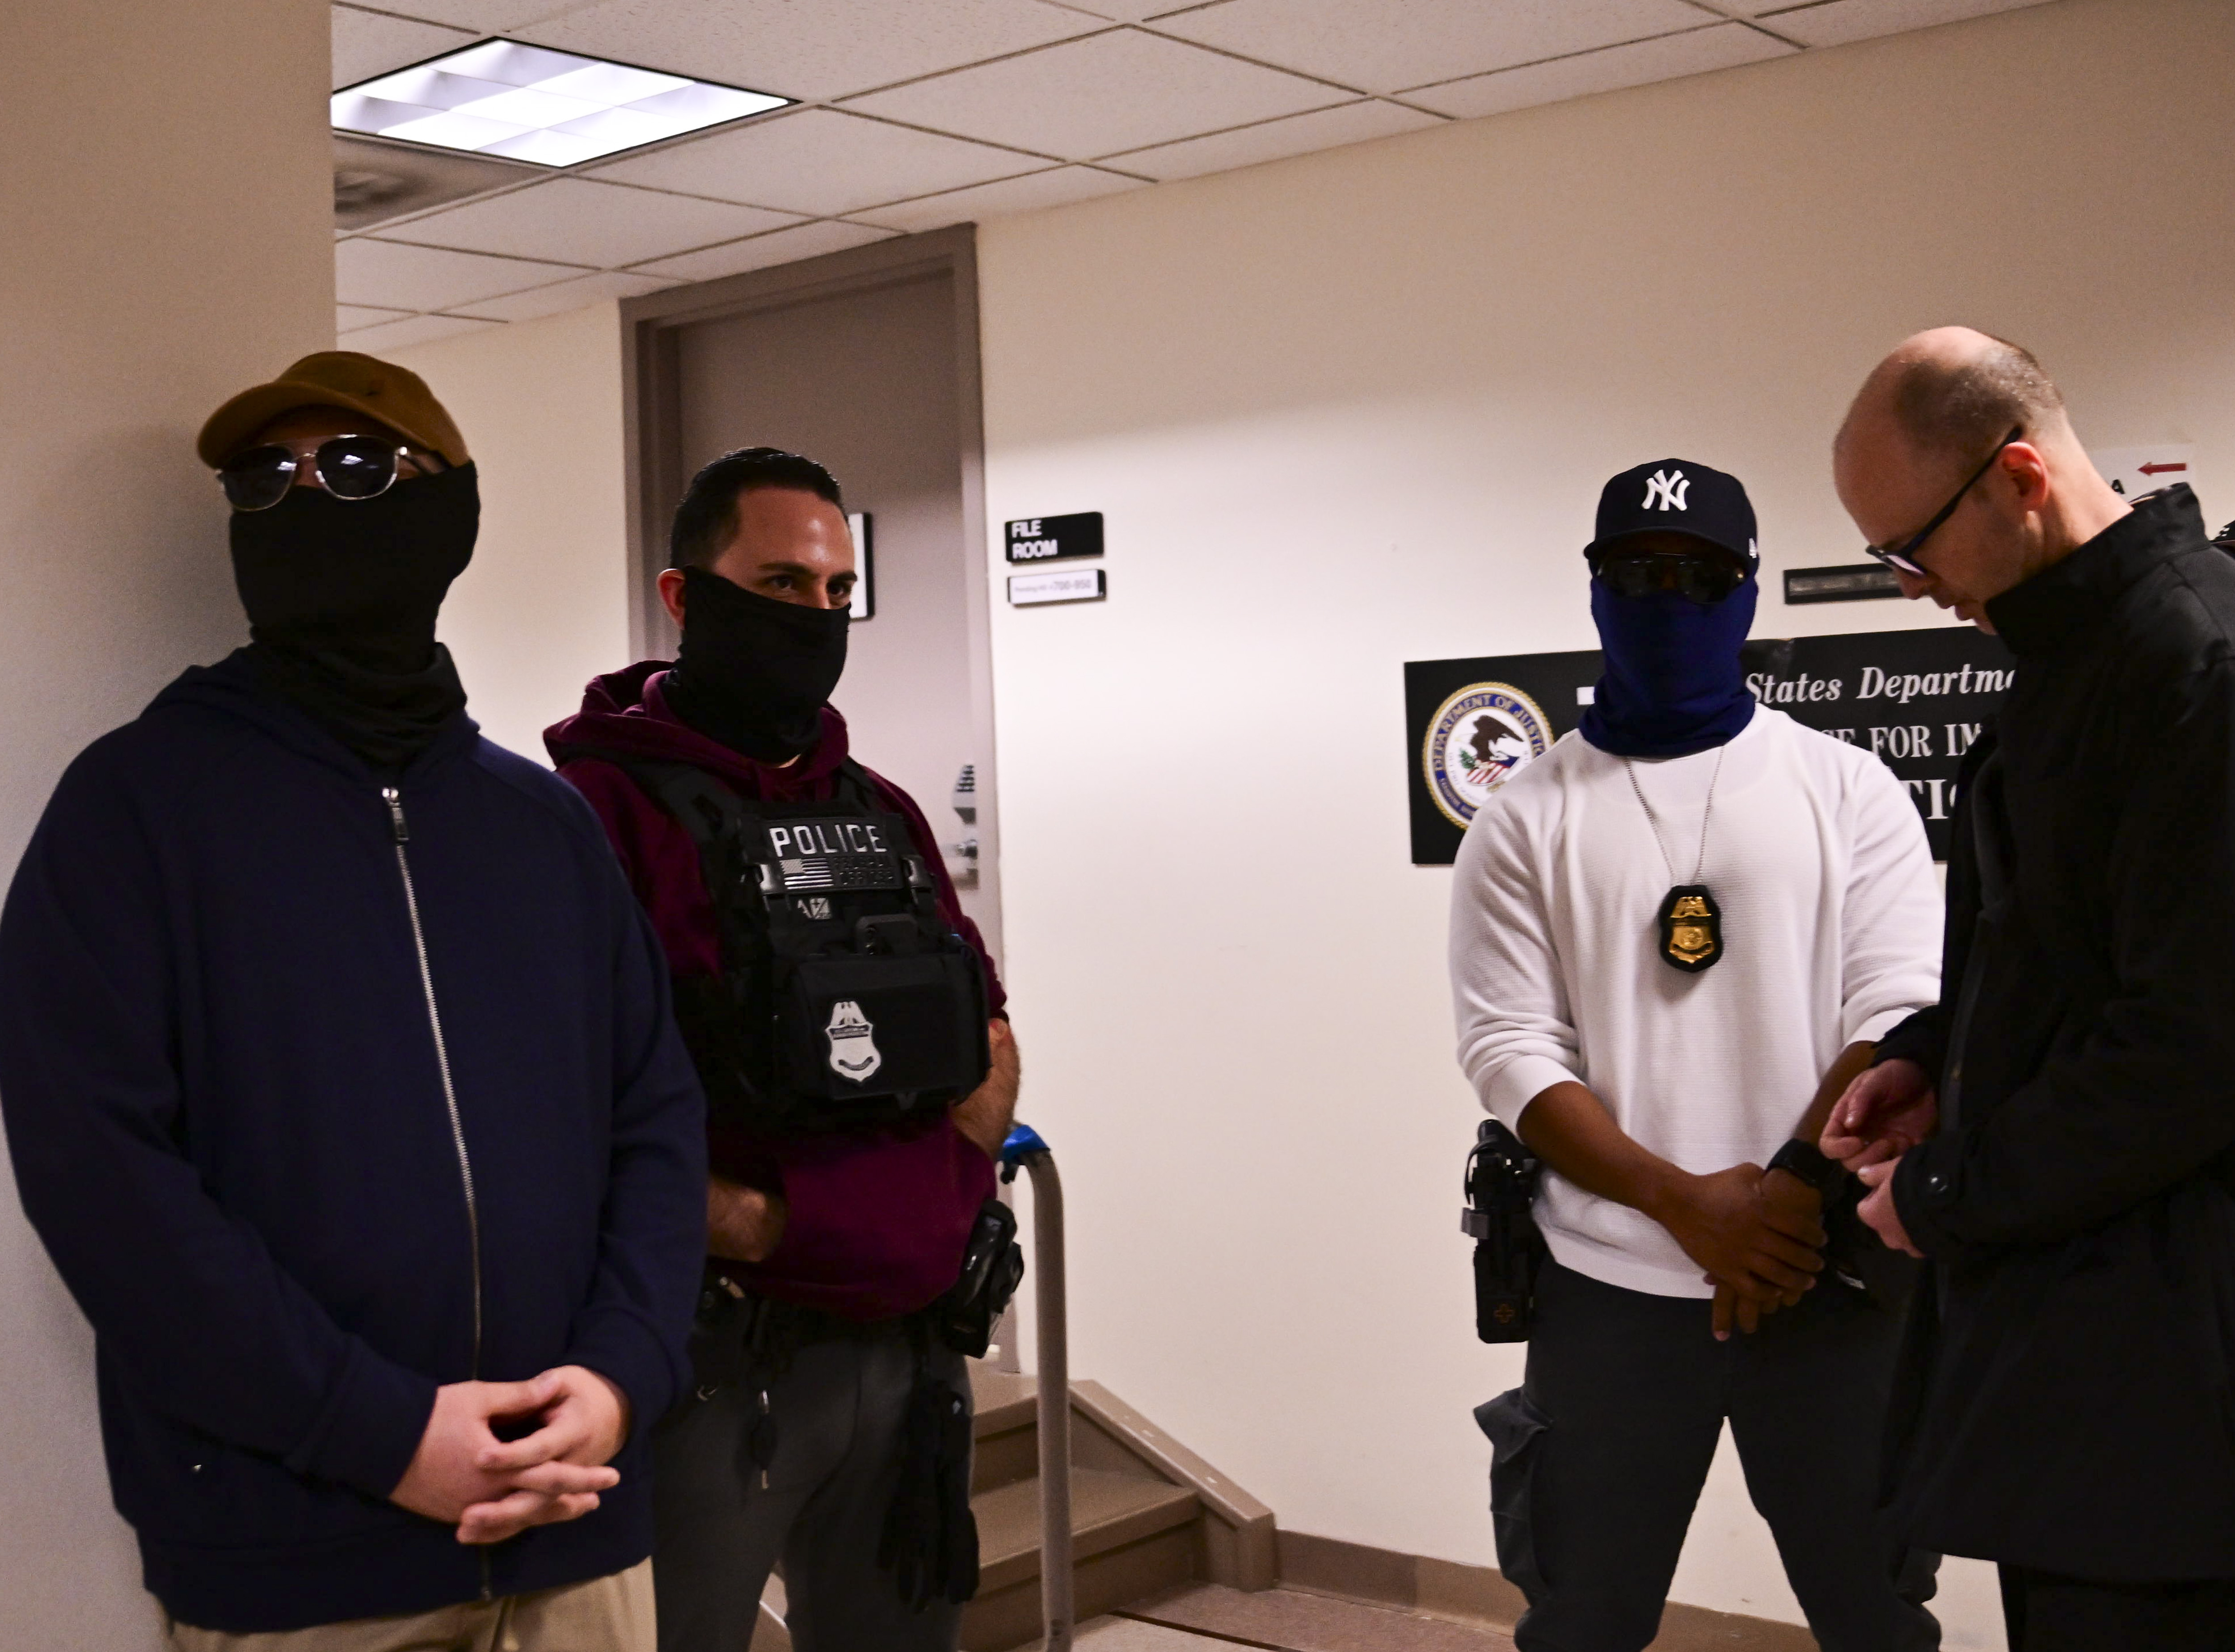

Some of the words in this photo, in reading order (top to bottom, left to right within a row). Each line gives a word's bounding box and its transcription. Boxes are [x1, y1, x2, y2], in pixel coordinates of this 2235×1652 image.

[1641, 469, 1690, 511] NY
[1011, 519, 1042, 538] FILE
[1012, 539, 1058, 559] ROOM
[1746, 673, 1843, 704] States
[1868, 725, 1933, 758] FOR
[769, 824, 887, 857] POLICE
